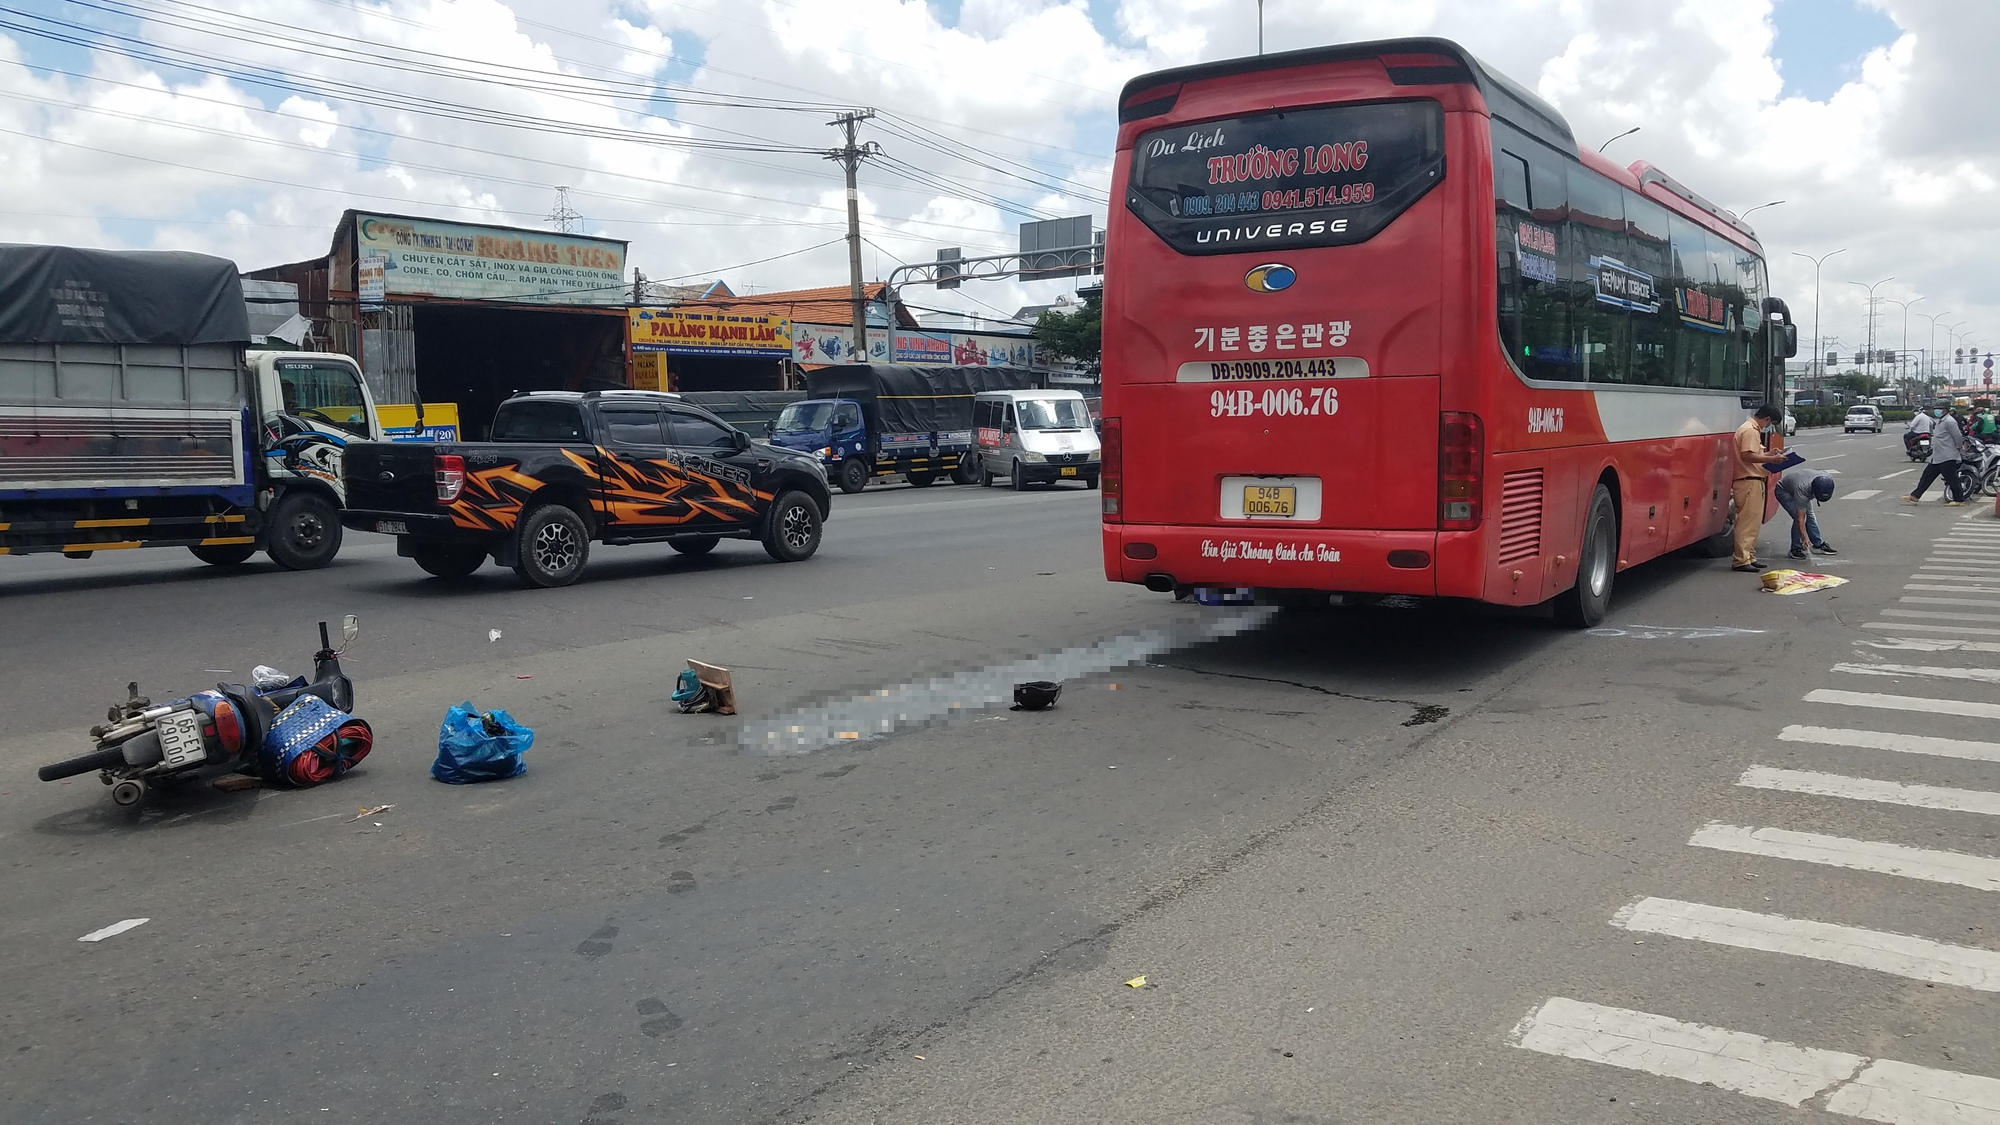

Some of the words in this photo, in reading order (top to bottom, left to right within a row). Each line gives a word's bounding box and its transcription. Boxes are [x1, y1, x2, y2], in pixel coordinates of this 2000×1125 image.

[1147, 137, 1177, 158] Du
[1181, 128, 1226, 153] Lịch
[1207, 144, 1299, 184] TRƯỜNG
[1303, 141, 1368, 175] LONG
[1183, 195, 1213, 216] 0909.
[1215, 193, 1236, 214] 204
[1238, 191, 1260, 212] 443
[1262, 182, 1375, 210] 0941.514.959
[1196, 218, 1348, 243] UNIVERSE
[403, 265, 433, 277] CONE,
[436, 268, 452, 278] CO,
[560, 279, 583, 288] THEO
[493, 262, 516, 271] INOX
[518, 263, 530, 272] VÀ
[533, 265, 548, 274] GIA
[550, 266, 574, 277] CÔNG
[651, 319, 707, 338] PALĂNG
[709, 325, 748, 342] MẠNH
[749, 324, 776, 342] LÂM
[1194, 320, 1352, 353] 기분좋은관광
[908, 337, 925, 351] VINH
[1211, 359, 1336, 380] DĐ:0909.204.443
[1210, 387, 1339, 418] 94B-006.76
[1528, 406, 1564, 434] 94B-006.76
[439, 430, 452, 440] 20
[1258, 487, 1280, 500] 94B
[1248, 501, 1289, 514] 006.76
[1201, 540, 1219, 558] Xin
[1238, 541, 1274, 563] Khoảng
[1275, 542, 1297, 561] Cách
[1298, 543, 1315, 561] An
[1316, 543, 1341, 562] Toàn
[158, 718, 185, 764] 290.00
[176, 718, 202, 754] 65-E1
